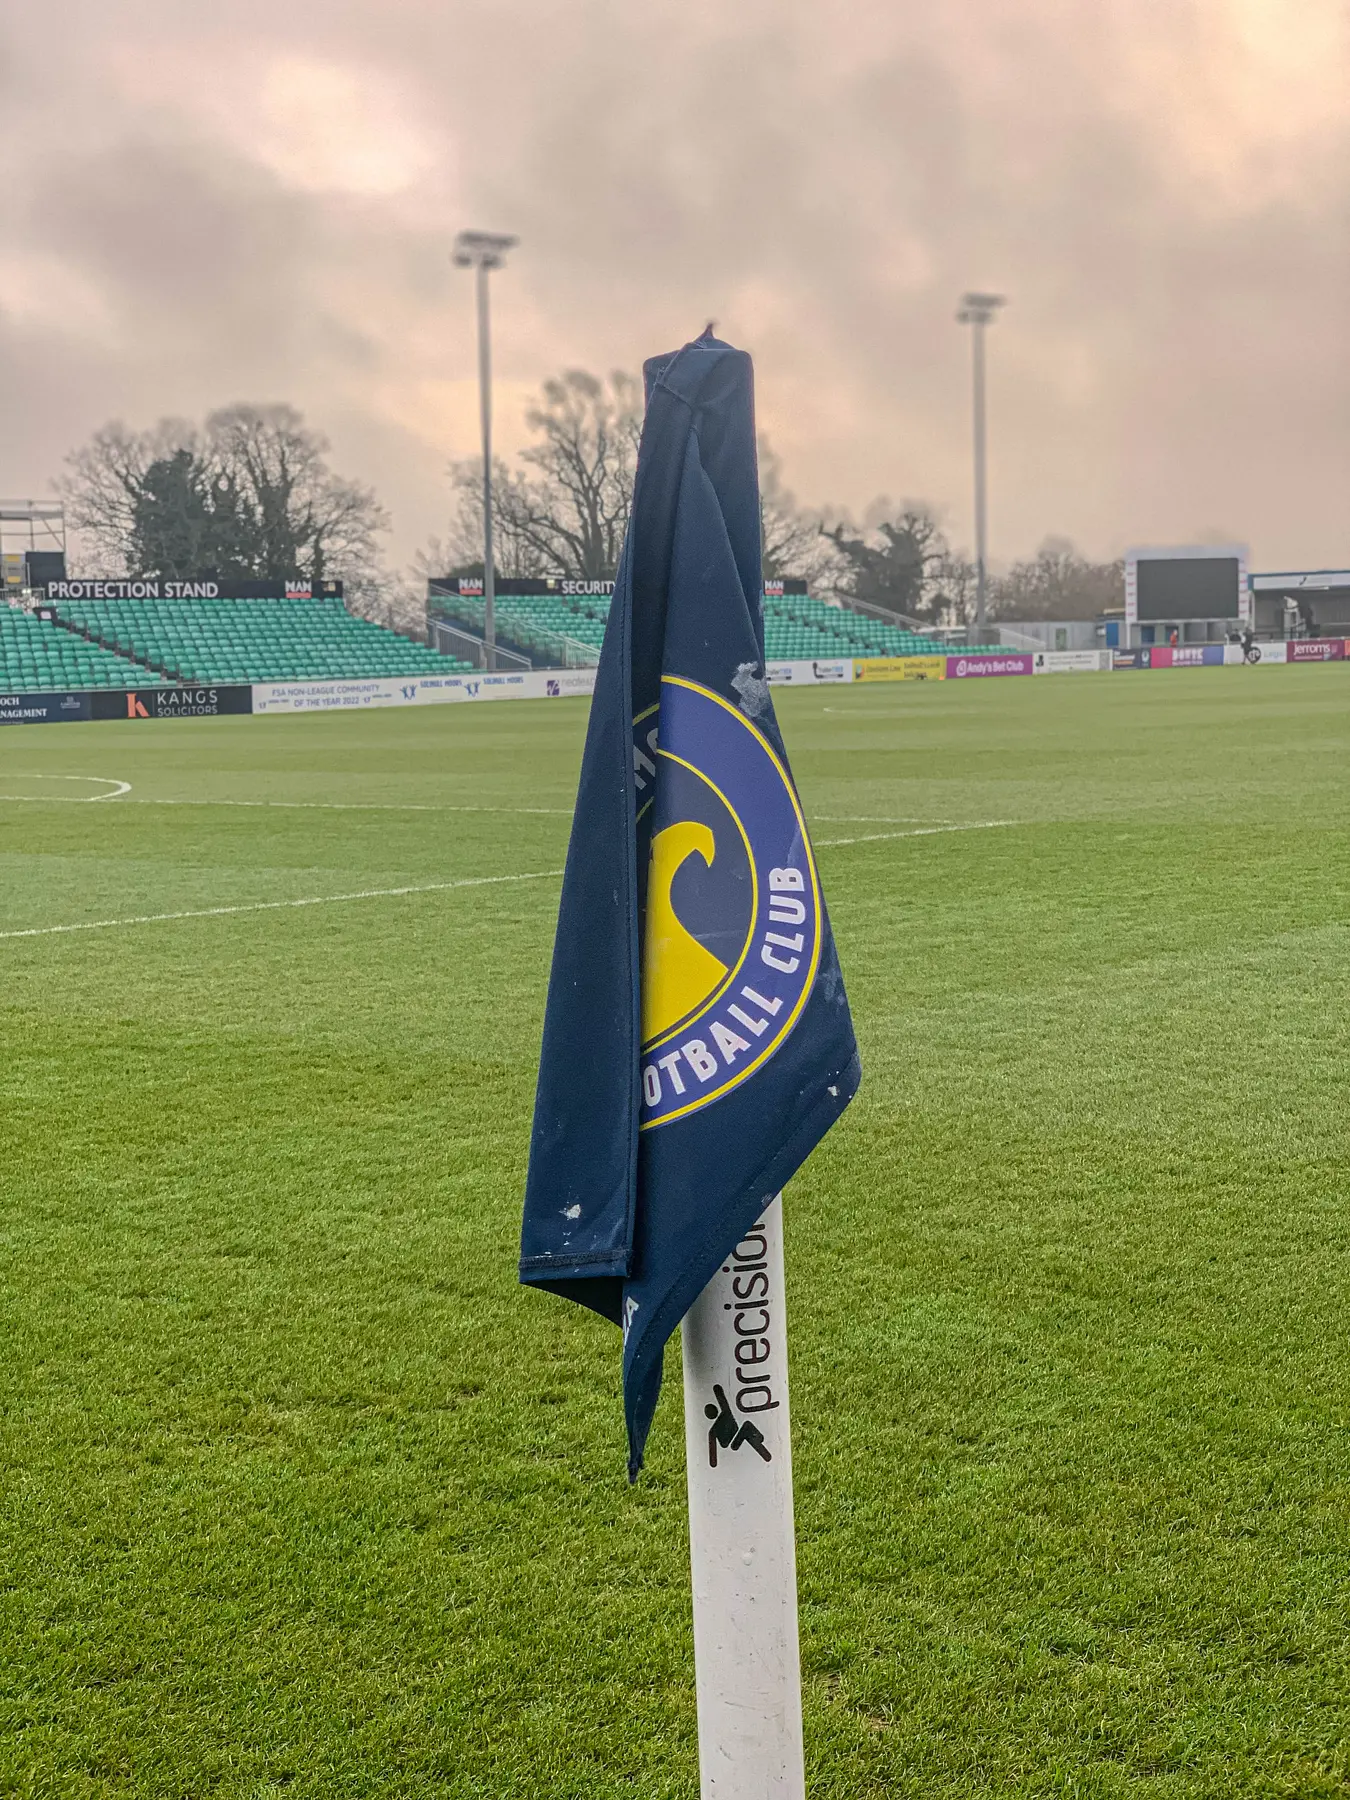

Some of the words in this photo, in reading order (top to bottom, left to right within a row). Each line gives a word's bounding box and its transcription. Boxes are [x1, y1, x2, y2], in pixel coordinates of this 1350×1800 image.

[48, 581, 159, 598] PROTECTION
[165, 581, 218, 598] STAND
[967, 661, 993, 675] Andy's
[993, 661, 1006, 672] Bet
[1006, 660, 1024, 672] Club
[157, 690, 218, 705] KANGS
[272, 689, 286, 697] FSA
[287, 686, 335, 696] NON-LEAGUE
[336, 684, 380, 694] COMMUNITY
[294, 699, 304, 707] OF
[306, 698, 323, 706] THE
[322, 697, 341, 706] YEAR
[342, 696, 360, 705] 2022
[157, 705, 218, 717] SOLICITORS
[761, 867, 806, 974] CLUB
